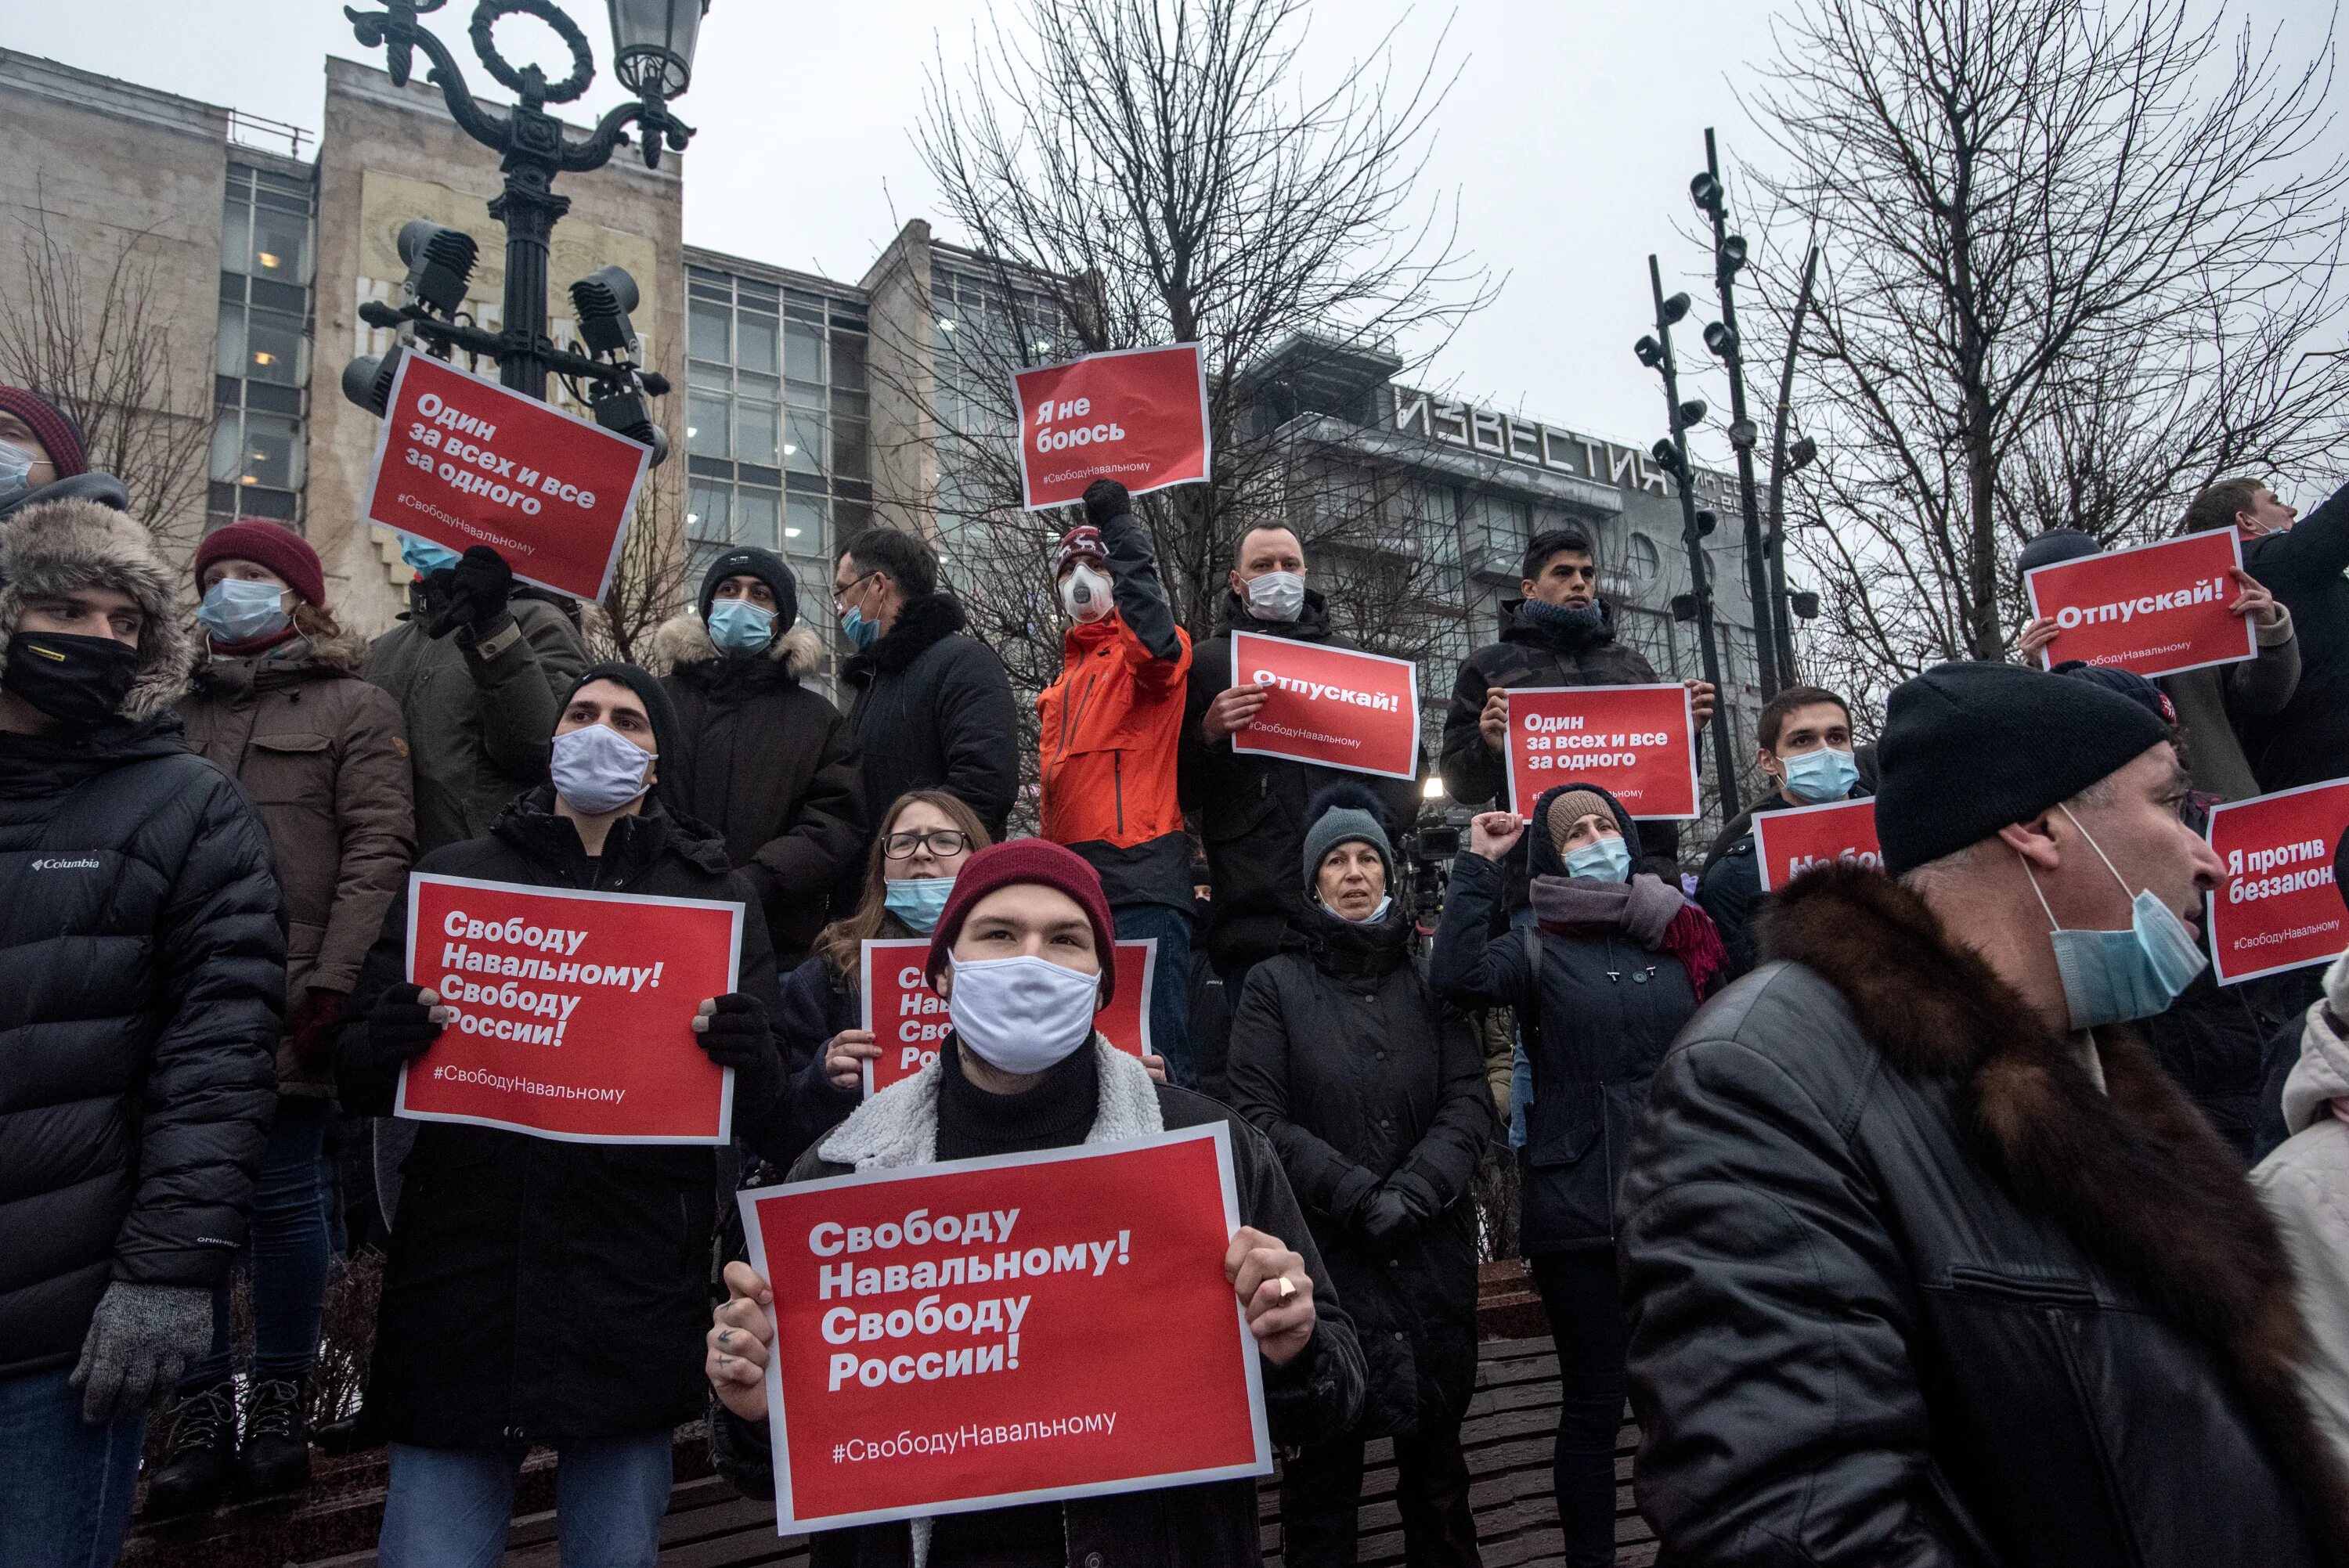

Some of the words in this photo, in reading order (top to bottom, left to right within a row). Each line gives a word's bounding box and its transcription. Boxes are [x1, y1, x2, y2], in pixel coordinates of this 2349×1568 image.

[417, 393, 496, 442] Один
[1035, 400, 1055, 426] Я
[1058, 398, 1090, 420] не
[1037, 424, 1125, 453] боюсь
[1395, 387, 1668, 496] ИЗВЕСТИЯ
[406, 448, 434, 473] за
[438, 463, 541, 515] одного
[409, 423, 442, 448] за
[443, 437, 516, 478] всех
[516, 467, 540, 487] и
[540, 476, 596, 509] все
[1044, 463, 1150, 484] #СвободуНавальному
[397, 493, 536, 556] #СвободуНавальному
[2057, 577, 2223, 629] Отпускай!
[1253, 669, 1399, 712] Отпускай!
[1249, 721, 1361, 748] #СвободуНавальному
[1525, 713, 1584, 734] Один
[1527, 736, 1551, 750] за
[1555, 734, 1607, 749] всех
[1611, 734, 1625, 747] и
[1629, 732, 1668, 746] все
[1528, 755, 1553, 770] за
[1557, 753, 1636, 771] одного
[44, 859, 99, 868] Columbia
[2228, 849, 2243, 876] Я
[2248, 838, 2325, 874] против
[2229, 865, 2336, 903] беззакон
[444, 910, 588, 956] Свободу
[2234, 920, 2340, 950] #СвободуНавальному
[442, 943, 664, 993] Навальному!
[440, 974, 581, 1021] Свободу
[442, 1005, 567, 1047] России!
[434, 1065, 626, 1104] #СвободуНавальному
[808, 1208, 1020, 1256] Свободу
[819, 1230, 1131, 1299] Навальному!
[821, 1295, 1031, 1344] Свободу
[828, 1332, 1020, 1392] России!
[832, 1411, 1117, 1464] #СвободуНавальному
